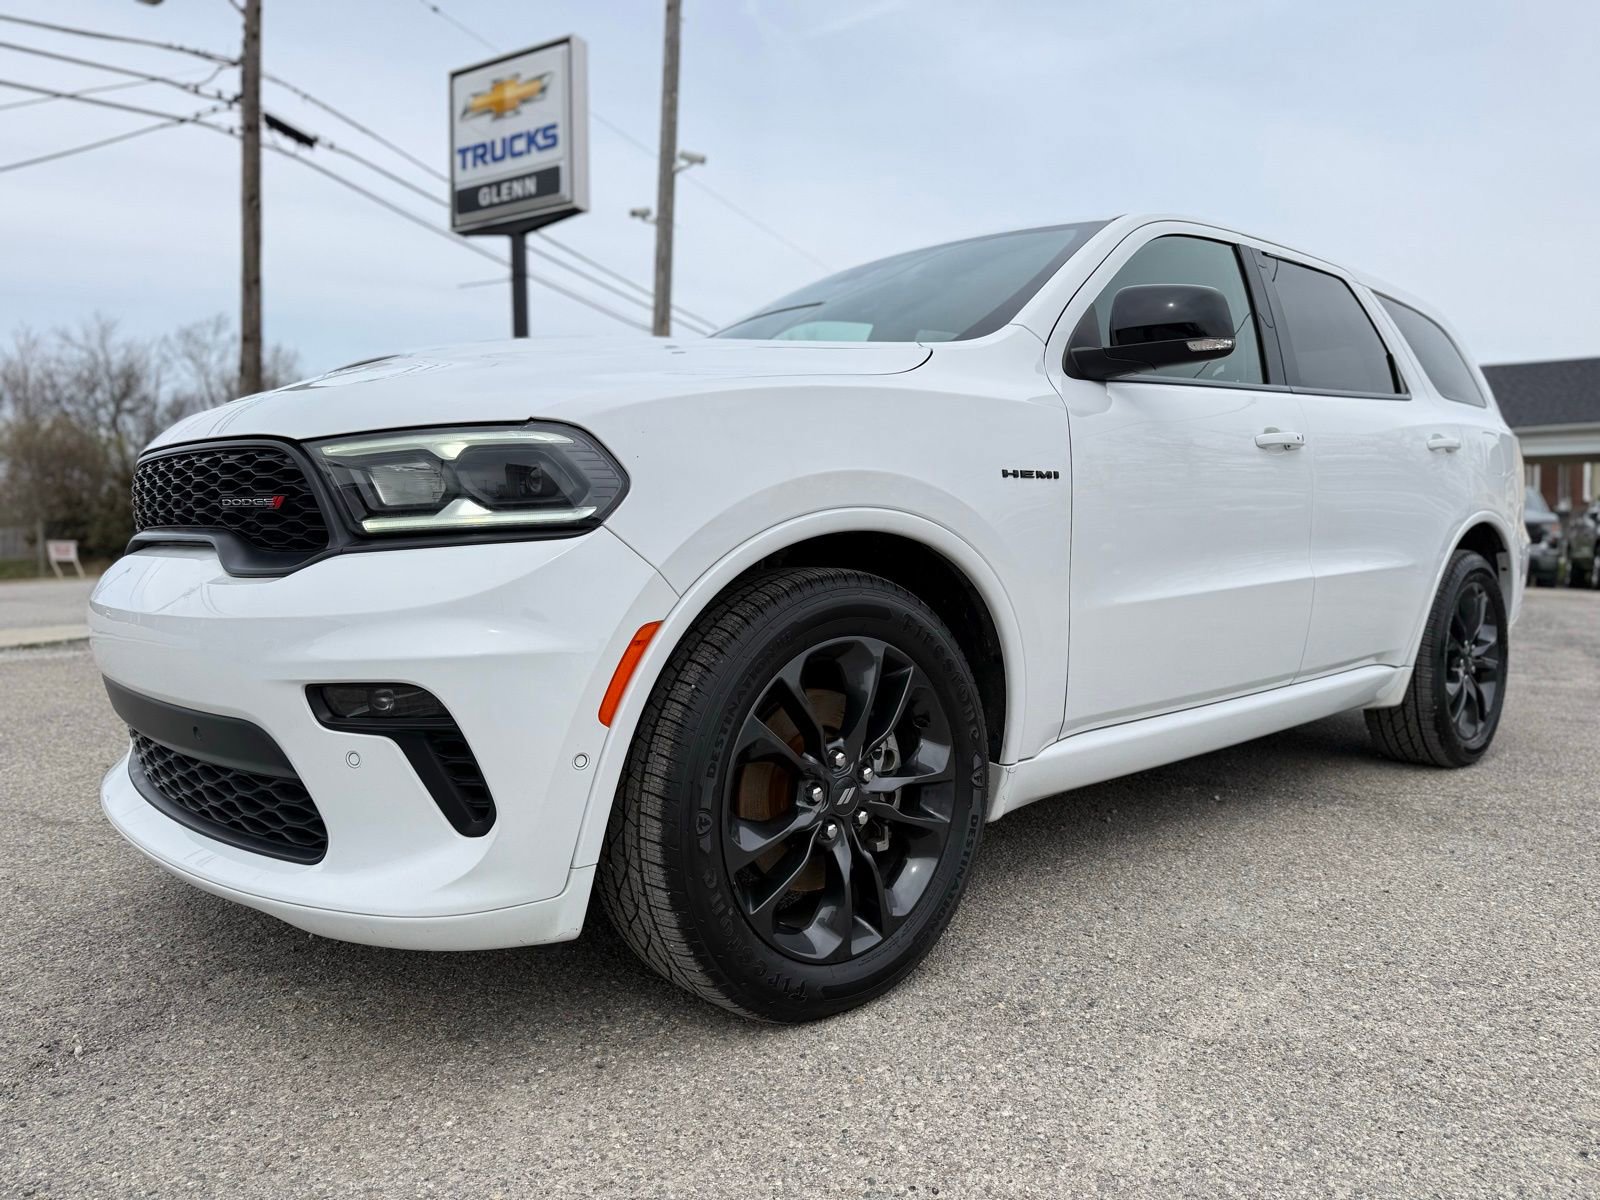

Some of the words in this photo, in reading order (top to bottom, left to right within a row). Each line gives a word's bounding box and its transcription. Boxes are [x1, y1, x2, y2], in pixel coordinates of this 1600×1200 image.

[457, 123, 558, 171] TRUCKS
[478, 175, 537, 207] GLENN
[1001, 469, 1060, 480] HEMI
[221, 498, 274, 506] DODGE
